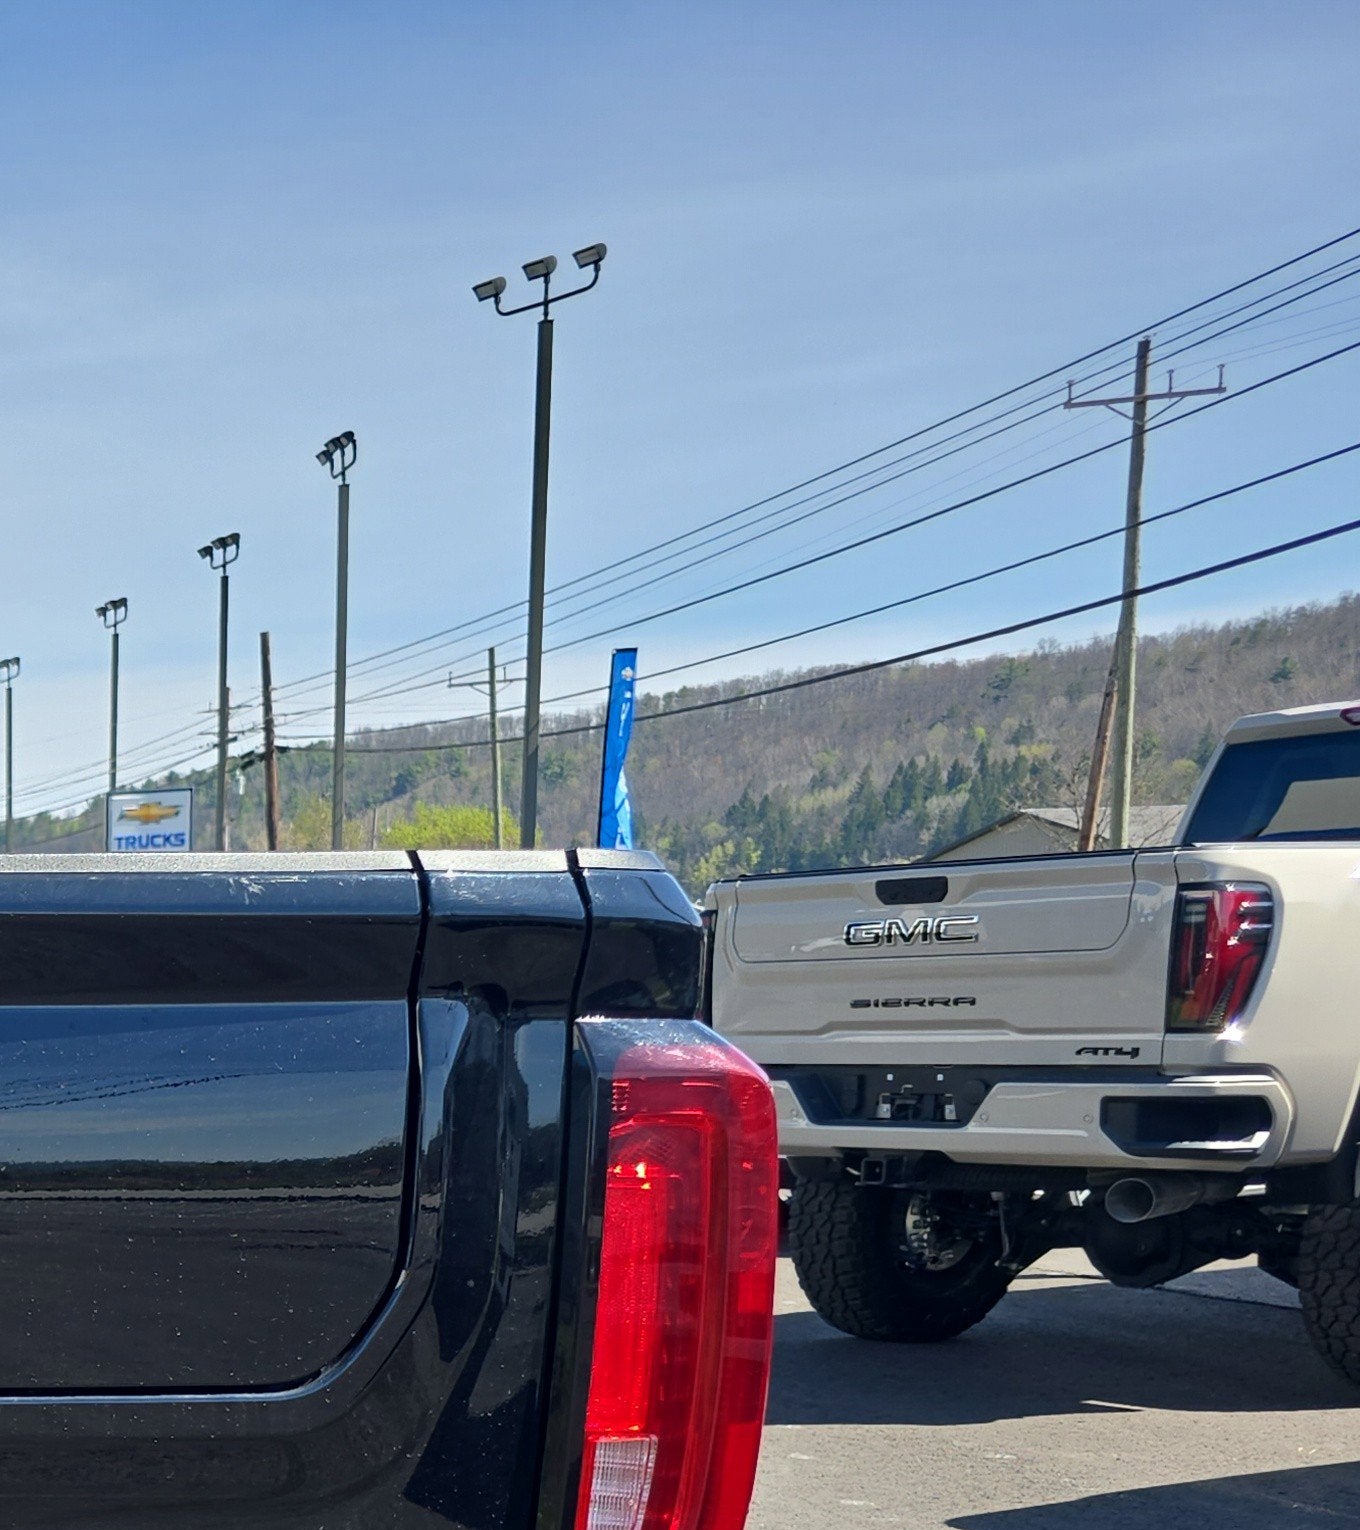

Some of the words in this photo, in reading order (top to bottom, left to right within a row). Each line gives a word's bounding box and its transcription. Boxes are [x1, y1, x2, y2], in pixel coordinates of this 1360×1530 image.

[114, 832, 185, 850] TRUCKS
[843, 914, 979, 947] GMC
[849, 996, 977, 1008] SIERRA
[1075, 1047, 1140, 1059] AT4
